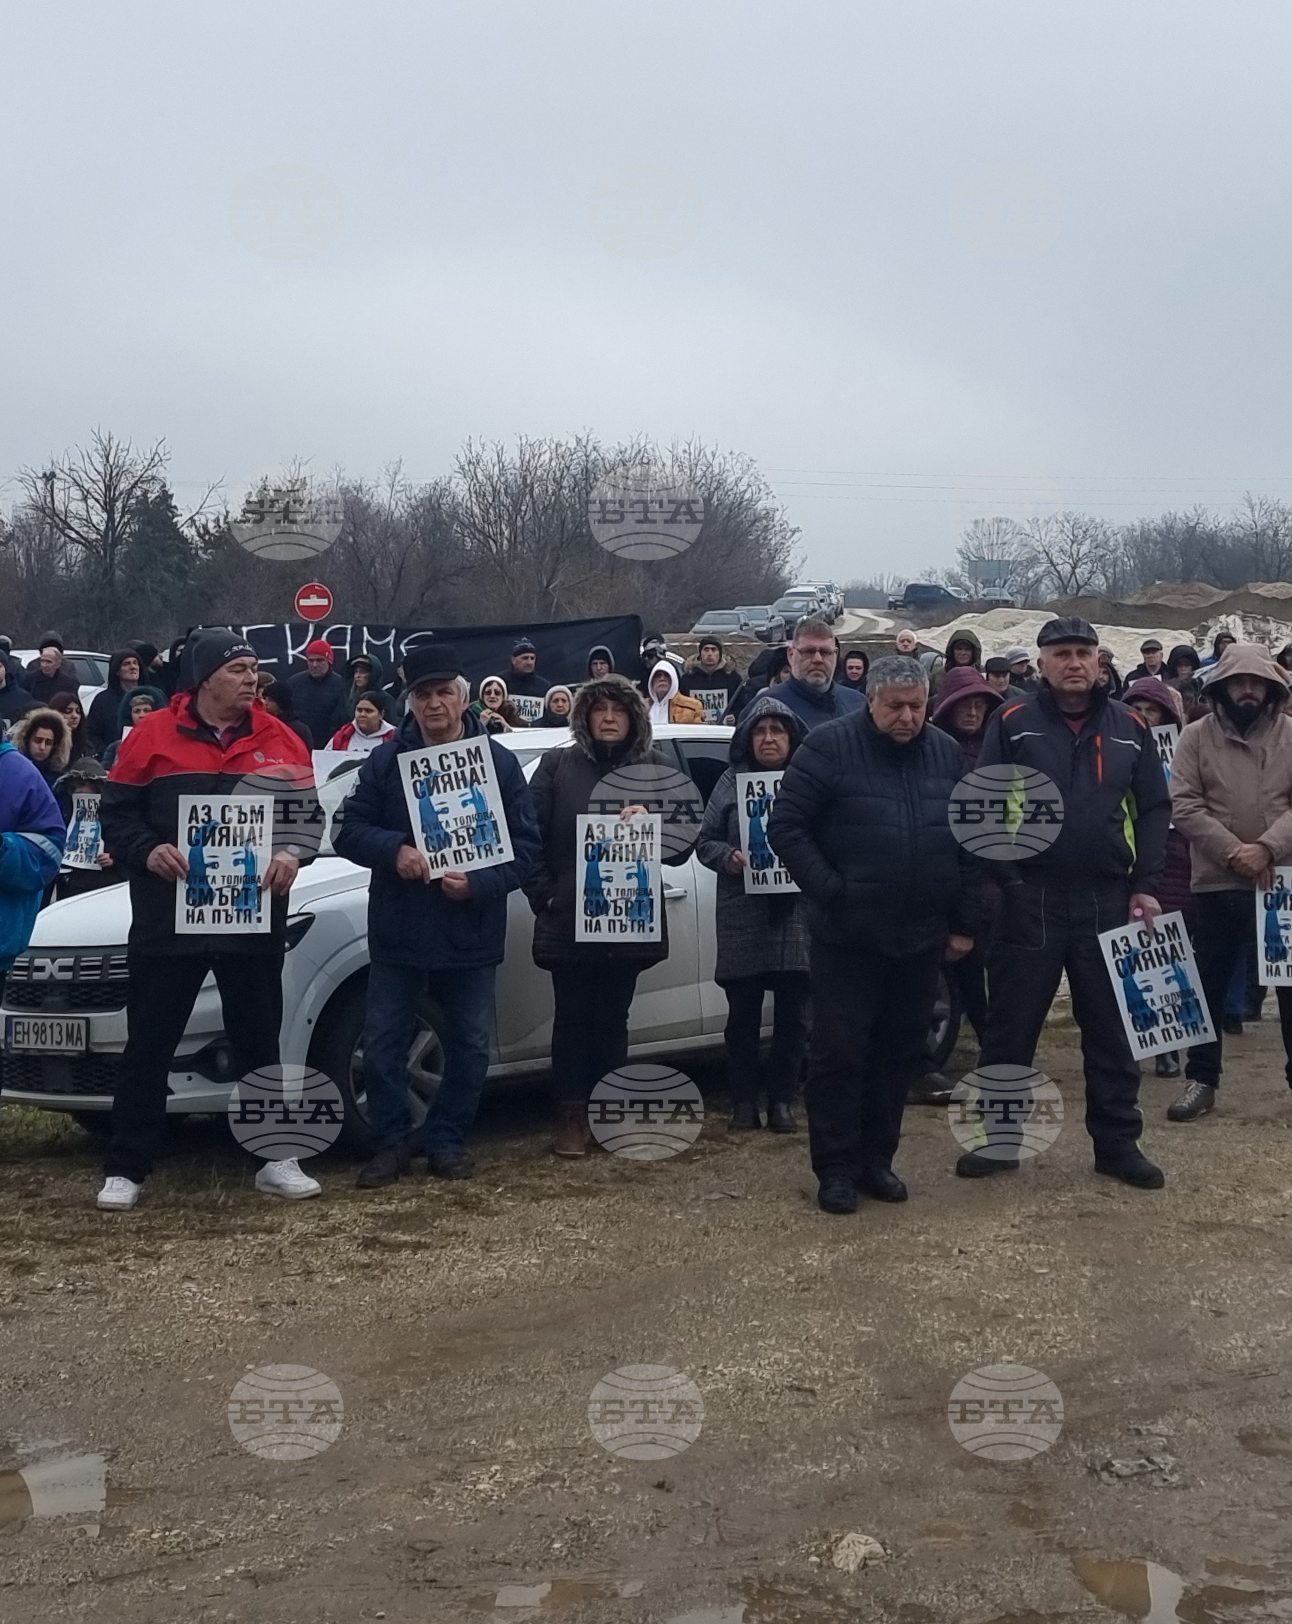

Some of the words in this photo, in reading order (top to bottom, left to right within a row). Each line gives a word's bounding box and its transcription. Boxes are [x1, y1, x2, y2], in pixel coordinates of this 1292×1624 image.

[410, 757, 432, 779] АЗ
[439, 746, 484, 772] СЪМ
[412, 765, 488, 800] СИЯНА!
[746, 780, 766, 799] АЗ
[188, 804, 212, 824] АЗ
[221, 804, 264, 825] СЪМ
[187, 826, 263, 847] СИЯНА!
[424, 824, 488, 853] СМЪРТ
[584, 823, 606, 842] АЗ
[614, 823, 654, 842] СЪМ
[429, 853, 449, 870] НА
[584, 843, 654, 862] СИЯНА!
[221, 875, 261, 885] ТОЛКОВА
[751, 872, 768, 885] НА
[186, 888, 252, 906] СМЪРТ
[186, 909, 205, 924] НА
[583, 899, 645, 917] СМЪРТ
[584, 919, 601, 933] НА
[1110, 935, 1133, 959] АЗ
[1137, 922, 1182, 949] СЪМ
[1115, 942, 1187, 979] СИЯНА!
[1266, 964, 1282, 977] НА
[1137, 1032, 1158, 1050] НА
